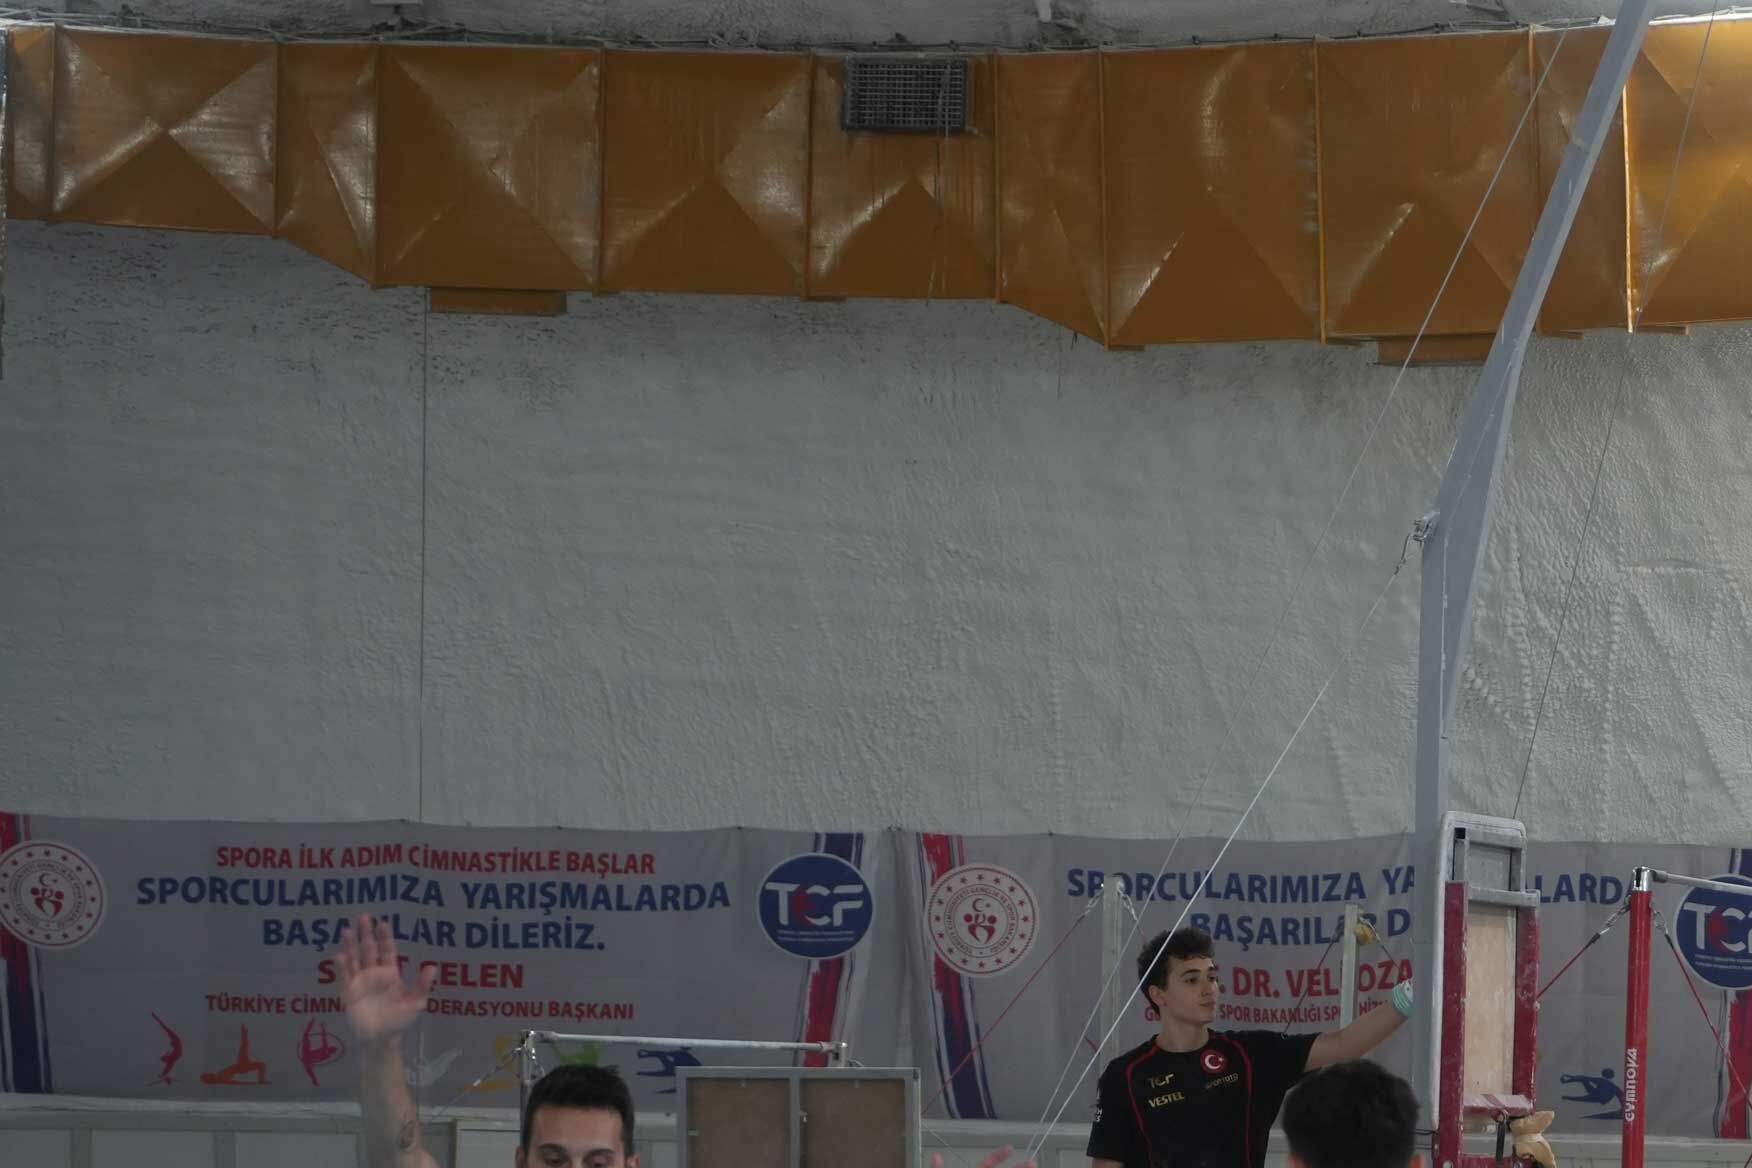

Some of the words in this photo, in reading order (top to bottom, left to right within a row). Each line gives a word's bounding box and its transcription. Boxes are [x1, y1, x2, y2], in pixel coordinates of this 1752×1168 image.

[216, 845, 293, 869] SPORA
[299, 843, 334, 869] İLK
[340, 843, 402, 869] ADIM
[408, 844, 561, 874] CİMNASTİKLE
[566, 851, 656, 879] BAŞLAR
[137, 874, 445, 907] SPORCULARIMIZA
[460, 880, 731, 915] YARIŞMALARDA
[765, 882, 864, 927] TCF
[263, 913, 456, 951] BAŞALAR
[465, 915, 606, 950] DİLERİZ.
[1232, 966, 1280, 998] DR.
[1286, 966, 1341, 998] VEL
[205, 992, 286, 1014] TÜRKİYE
[424, 998, 543, 1018] DERASYONU
[548, 1001, 635, 1022] BAŞKANI
[1219, 1007, 1250, 1022] SPOR
[1253, 1005, 1321, 1025] BAKANLIĞI
[1148, 1091, 1185, 1108] VESTEL
